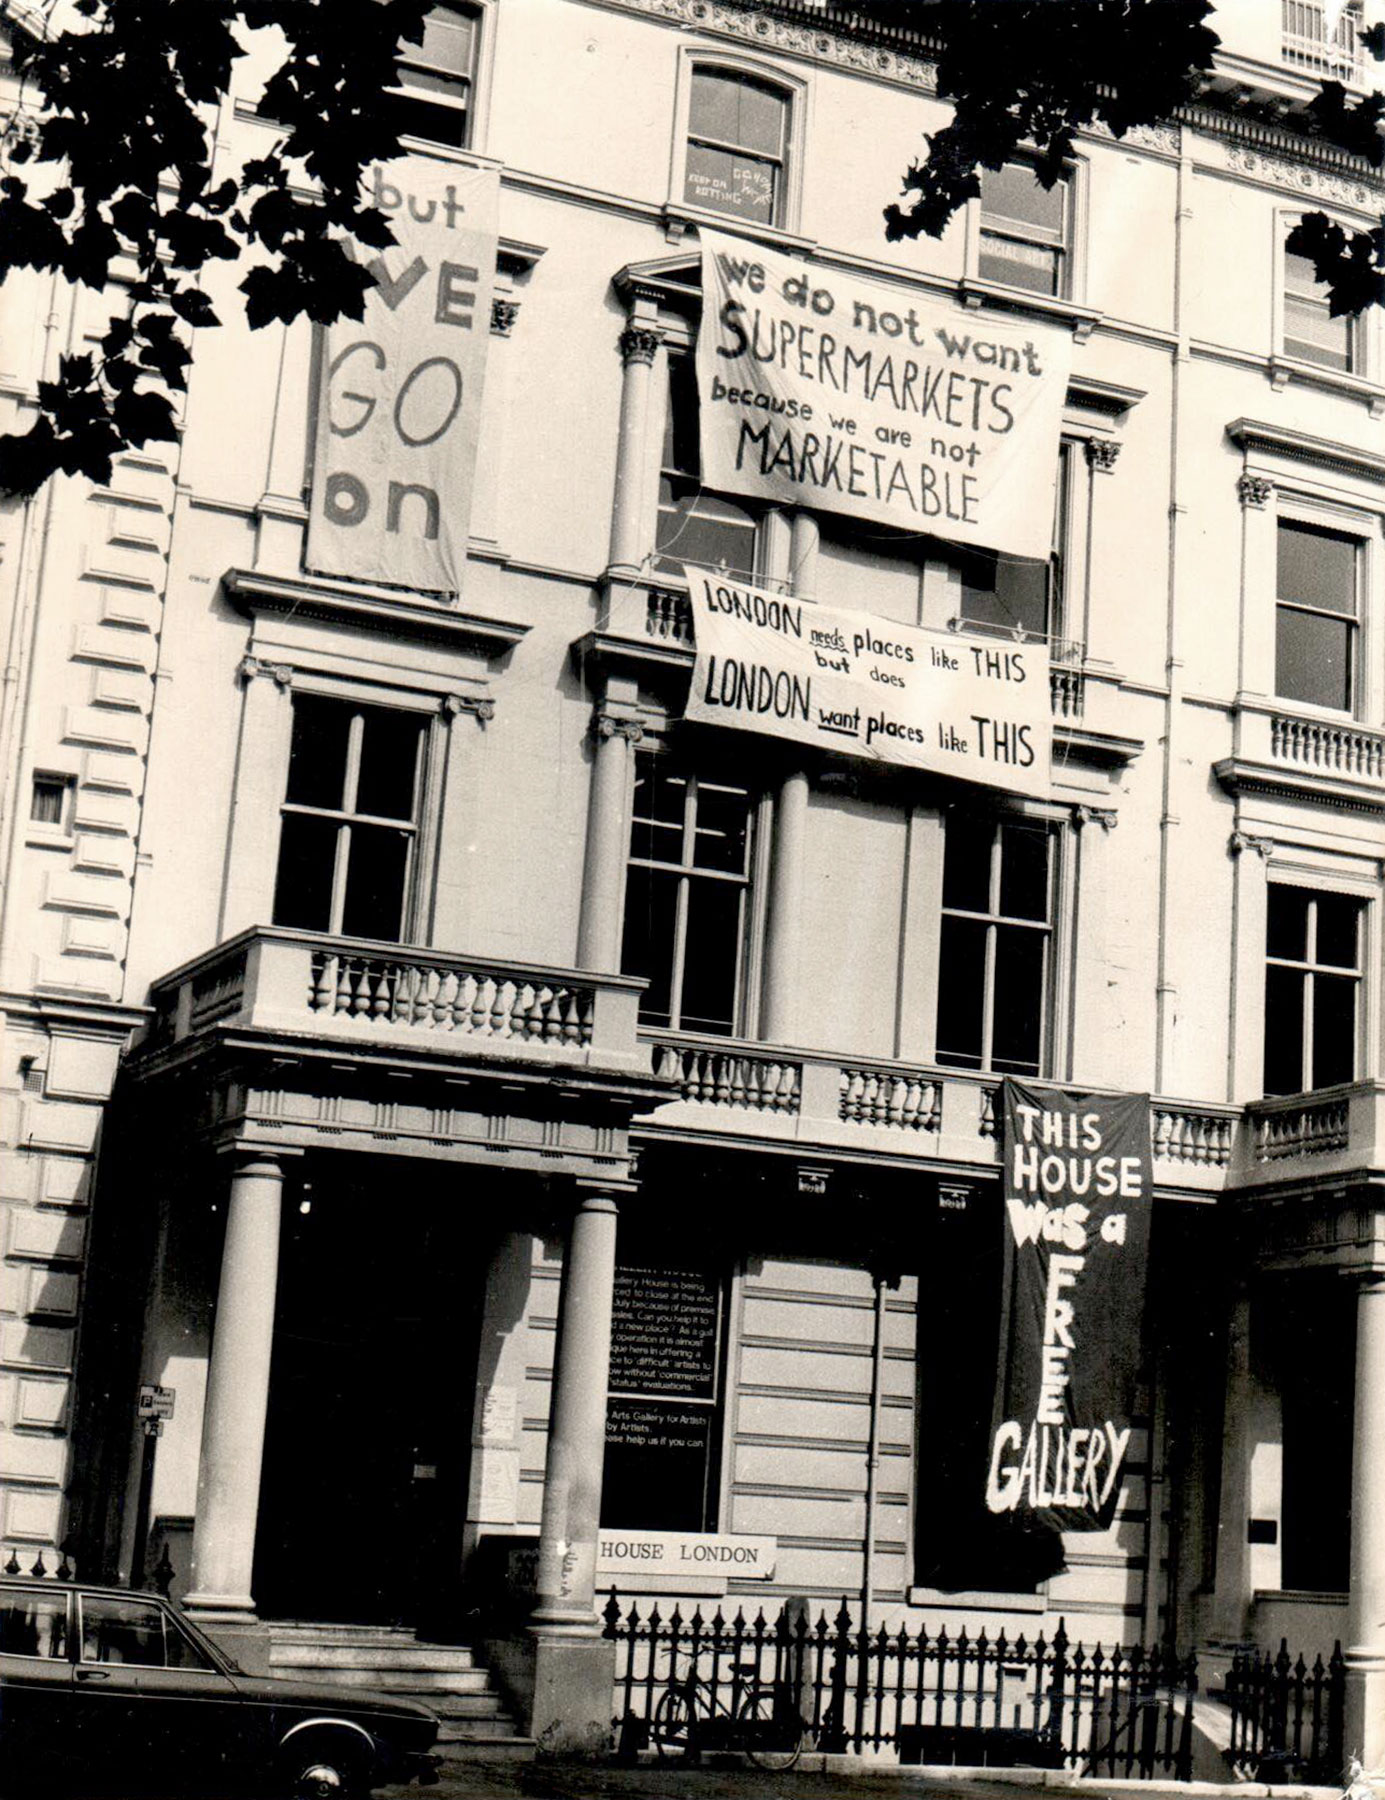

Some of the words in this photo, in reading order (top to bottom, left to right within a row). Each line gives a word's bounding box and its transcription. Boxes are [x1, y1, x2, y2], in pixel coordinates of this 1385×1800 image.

[373, 166, 465, 229] but
[718, 251, 765, 293] we
[783, 274, 835, 316] do
[853, 300, 925, 346] not
[934, 327, 1043, 377] want
[716, 300, 1014, 434] SUPERMARKETS
[329, 340, 463, 447] GO
[711, 376, 813, 421] because
[829, 413, 857, 436] we
[875, 425, 911, 448] are
[931, 437, 981, 468] not
[736, 418, 980, 525] MARKETABLE
[324, 472, 440, 540] on
[703, 579, 802, 638] LONDON
[810, 627, 845, 648] needs
[853, 629, 914, 662] places
[931, 647, 959, 671] like
[970, 647, 1027, 683] THIS
[815, 654, 851, 674] but
[869, 665, 905, 688] does
[704, 655, 811, 722] LONDON
[818, 707, 860, 731] want
[866, 711, 924, 745] places
[939, 722, 968, 753] like
[970, 715, 1035, 767] THIS
[1016, 1104, 1102, 1151] THIS
[1013, 1144, 1142, 1198] HOUSE
[1100, 1213, 1127, 1246] a
[613, 1276, 638, 1288] allery
[641, 1278, 669, 1289] House
[680, 1280, 705, 1292] being
[634, 1289, 644, 1298] to
[616, 1334, 658, 1346] operation
[637, 1310, 654, 1321] Can
[700, 1316, 709, 1325] to
[1037, 1254, 1085, 1424] FREE
[623, 1356, 633, 1365] to
[623, 1367, 656, 1378] without
[611, 1411, 631, 1421] Arts
[633, 1411, 664, 1424] Gallery
[667, 1413, 679, 1423] for
[679, 1414, 707, 1425] Artists
[625, 1434, 645, 1446] help
[648, 1437, 658, 1446] us
[668, 1438, 685, 1449] you
[986, 1420, 1131, 1514] GALLERY
[600, 1541, 665, 1560] HOUSE
[680, 1544, 759, 1564] LONDON
